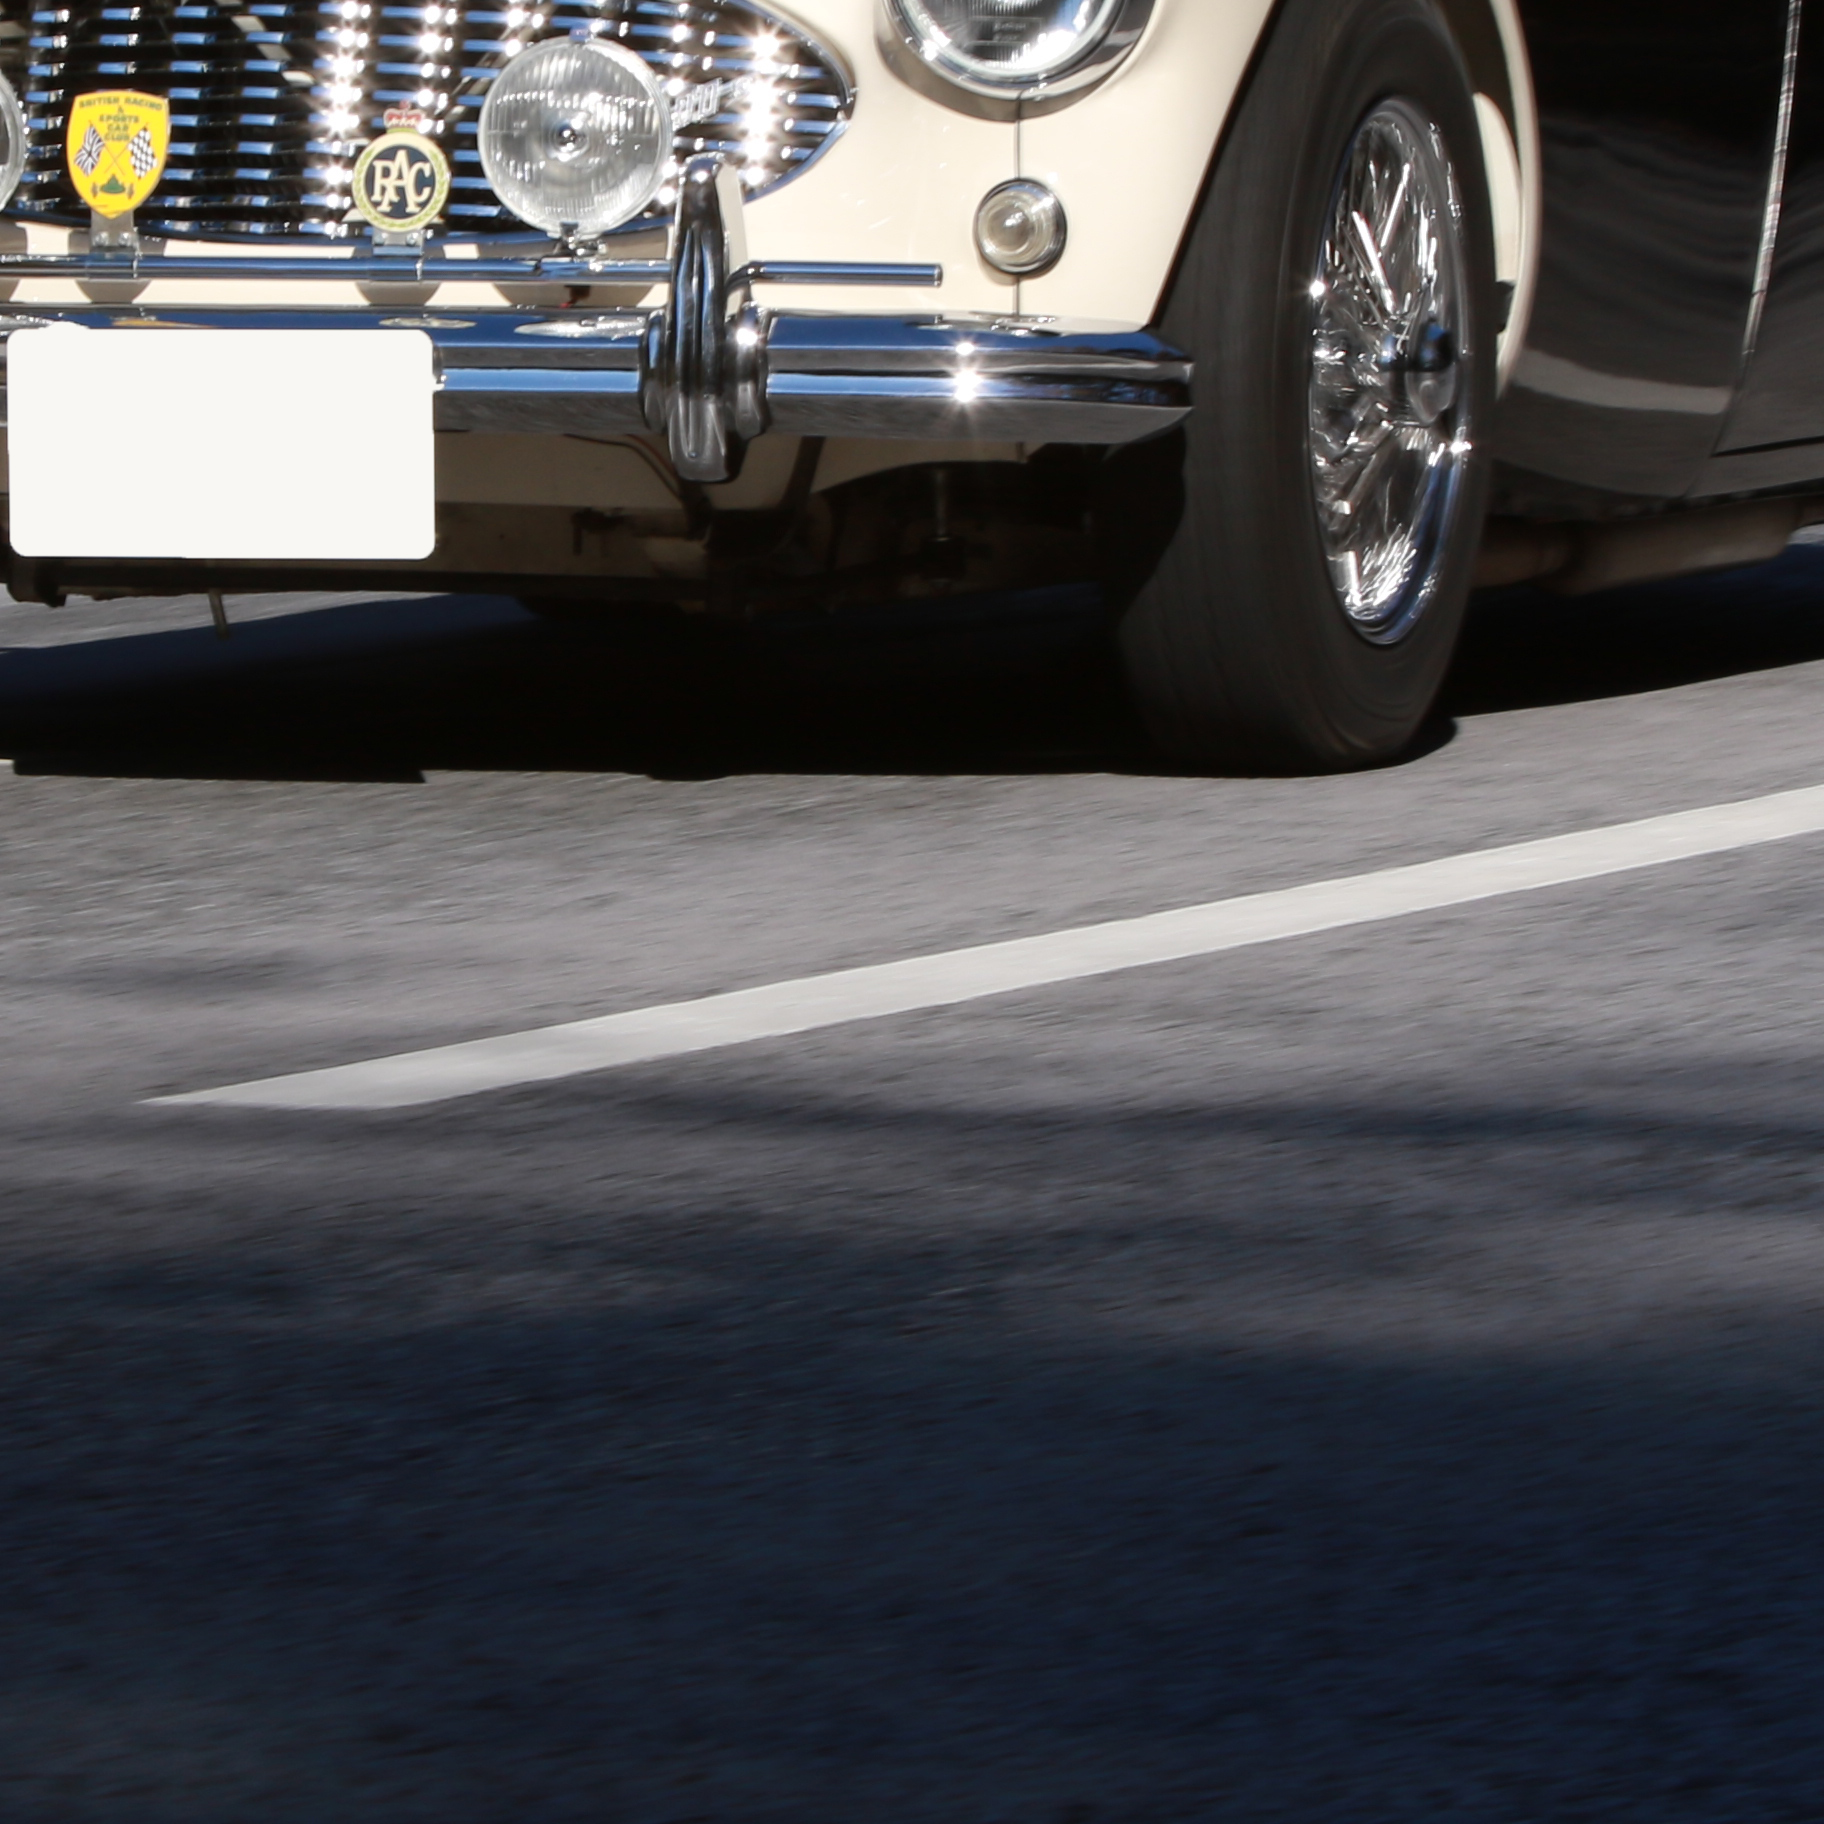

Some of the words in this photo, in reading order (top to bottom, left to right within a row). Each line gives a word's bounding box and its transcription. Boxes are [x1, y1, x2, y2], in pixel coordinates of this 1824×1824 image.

[79, 97, 120, 108] BRITISH
[124, 97, 163, 111] RACING
[99, 114, 139, 123] SPORTS
[107, 123, 129, 132] CAR
[104, 133, 130, 141] CLUB
[370, 149, 433, 213] RAC
